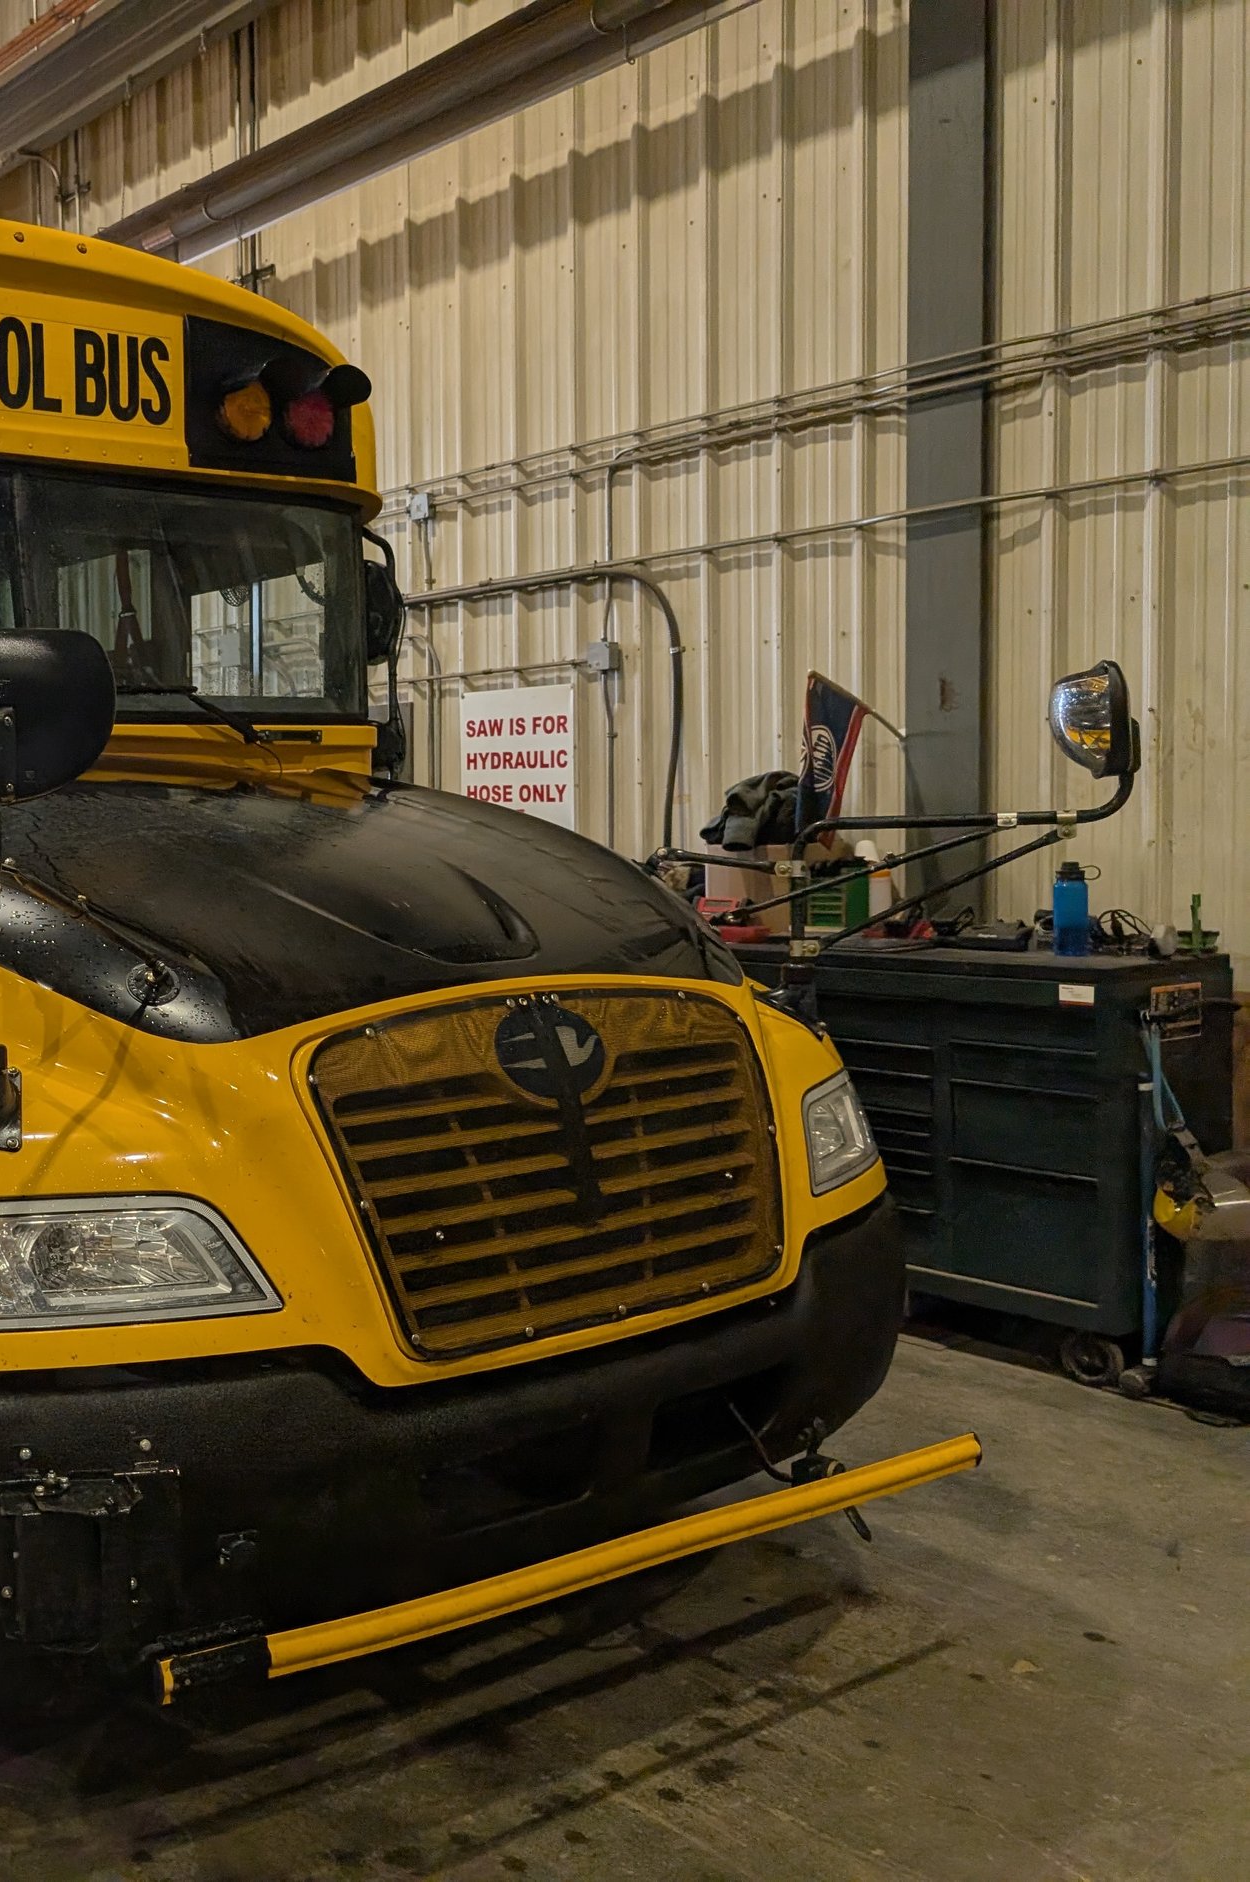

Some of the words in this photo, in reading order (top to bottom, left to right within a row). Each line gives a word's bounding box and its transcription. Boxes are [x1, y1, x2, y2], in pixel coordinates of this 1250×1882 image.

[73, 327, 172, 426] BUS
[466, 719, 503, 738] SAW
[509, 717, 526, 736] IS
[532, 715, 568, 735] FOR
[466, 749, 568, 770] HYDRAULIC
[466, 784, 513, 803] HOSE
[519, 784, 567, 803] ONLY
